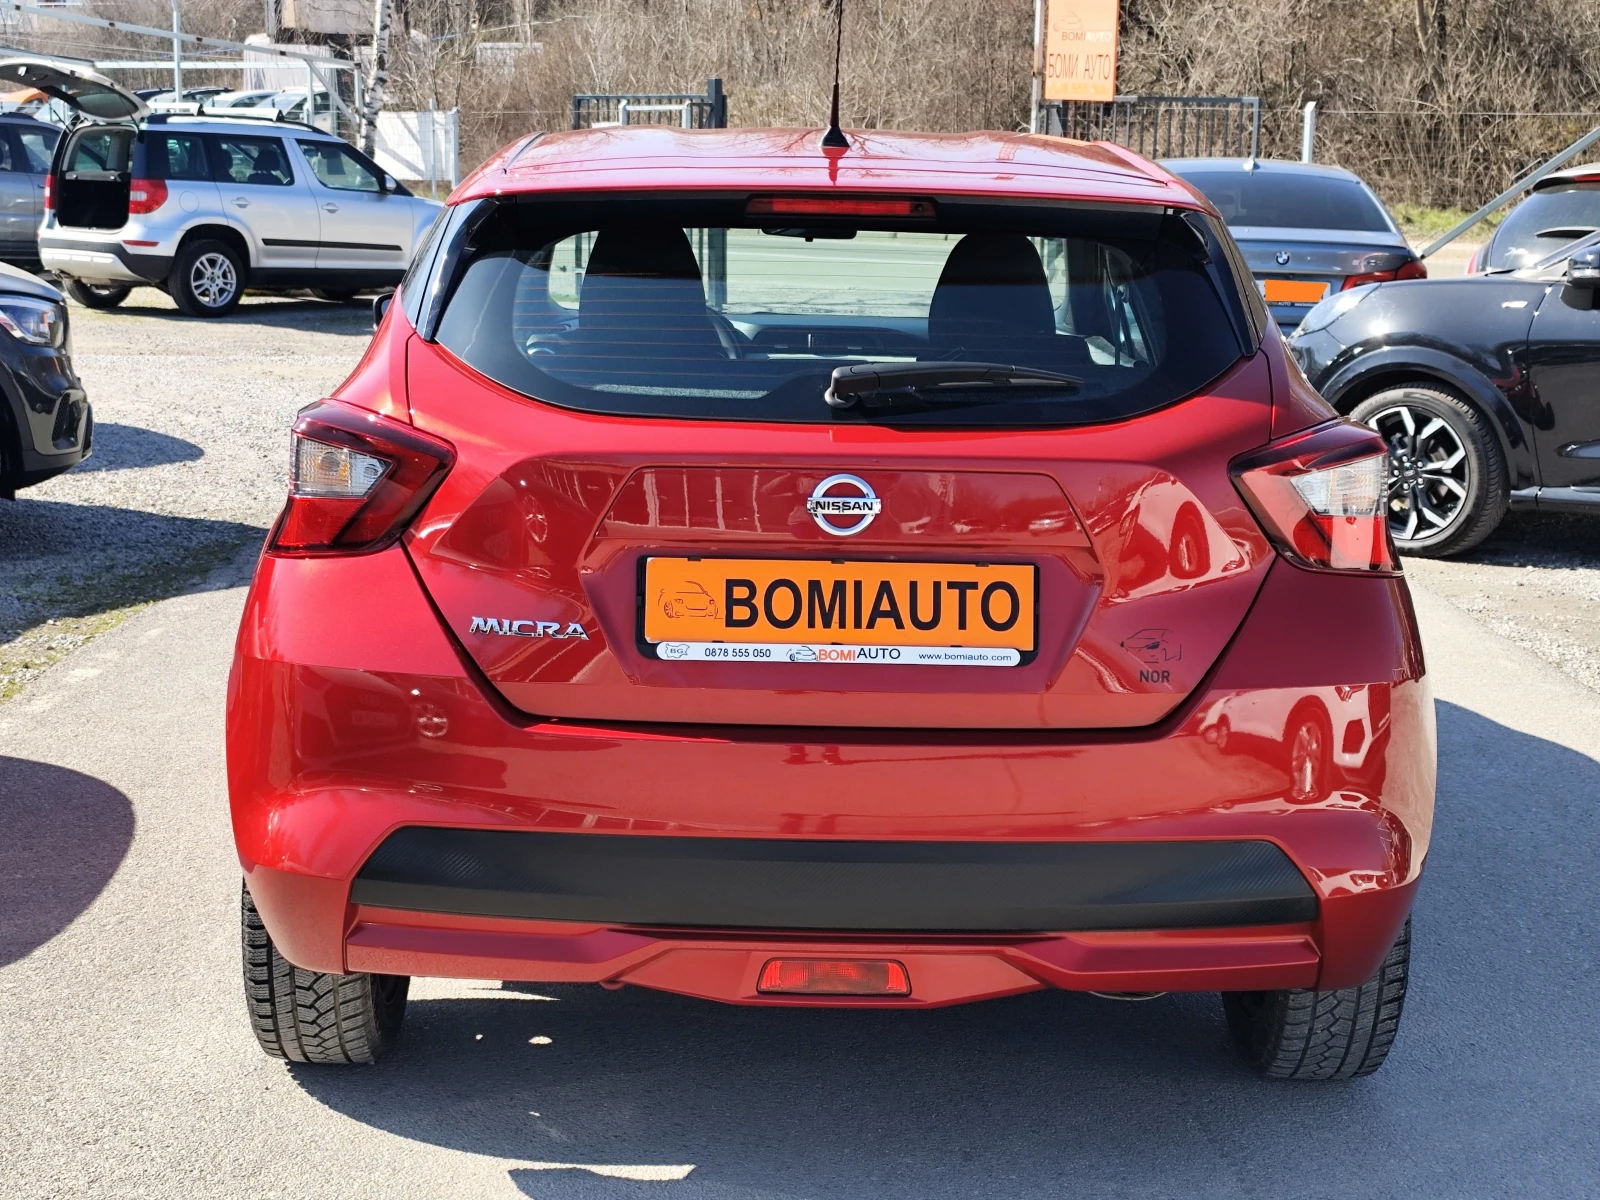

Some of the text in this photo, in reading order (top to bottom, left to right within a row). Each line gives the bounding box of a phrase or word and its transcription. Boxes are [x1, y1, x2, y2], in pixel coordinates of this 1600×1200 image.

[1061, 31, 1112, 42] BOMIAUTO
[1048, 53, 1079, 79] БОМИ
[815, 500, 874, 511] NISSAN
[724, 578, 1020, 632] BOMIAUTO
[468, 616, 590, 641] MICRA
[704, 647, 771, 658] 0878 555 050
[818, 647, 901, 661] BOMIAUTO
[918, 652, 1012, 661] www.bomiauto.com
[1140, 669, 1171, 683] NOR
